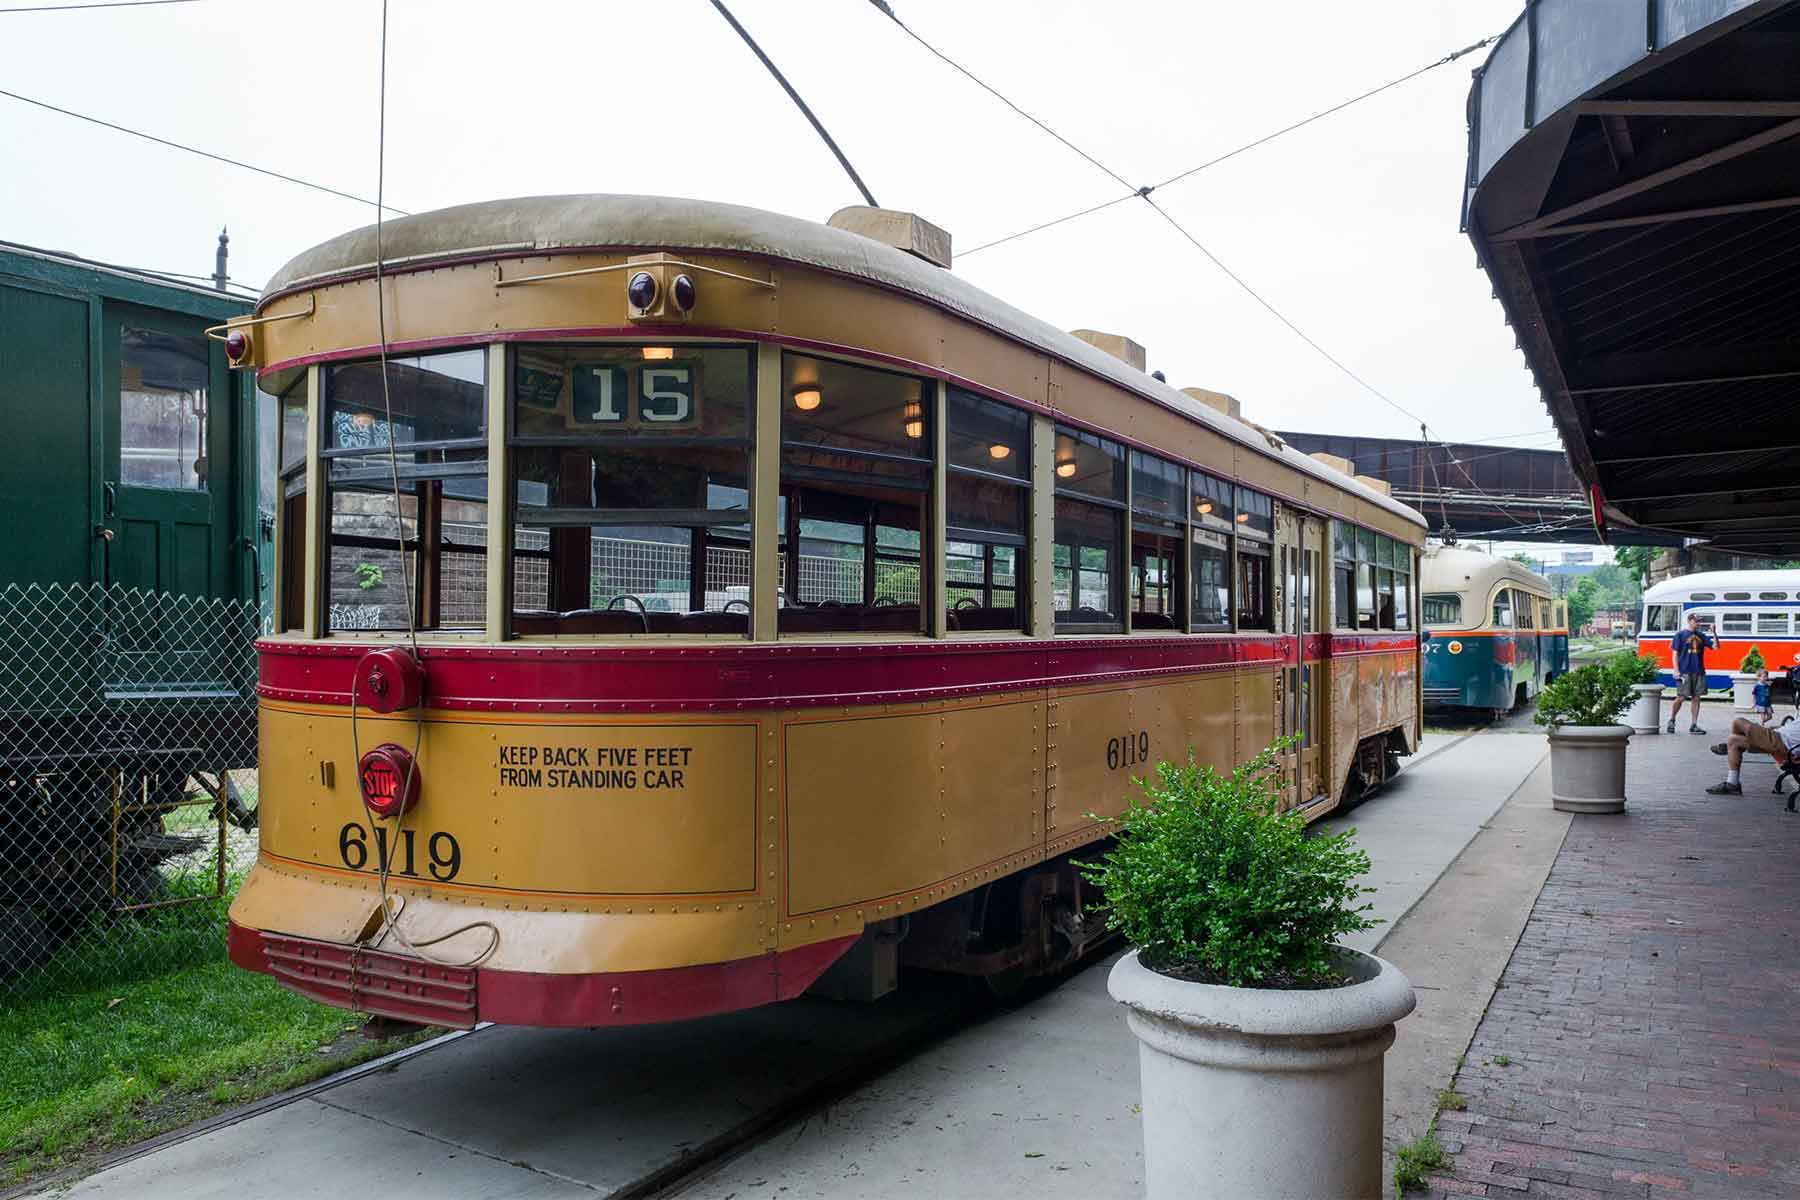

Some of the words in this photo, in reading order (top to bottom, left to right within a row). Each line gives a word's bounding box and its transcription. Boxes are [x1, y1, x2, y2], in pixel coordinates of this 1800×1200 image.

[499, 746, 538, 766] KEEP
[543, 747, 589, 766] BACK
[598, 748, 637, 767] FIVE
[644, 748, 692, 767] FEET
[1107, 731, 1149, 770] 6119
[500, 767, 542, 787] FROM
[547, 769, 637, 789] STANDING
[643, 770, 685, 789] CAR
[339, 822, 461, 881] 6119
